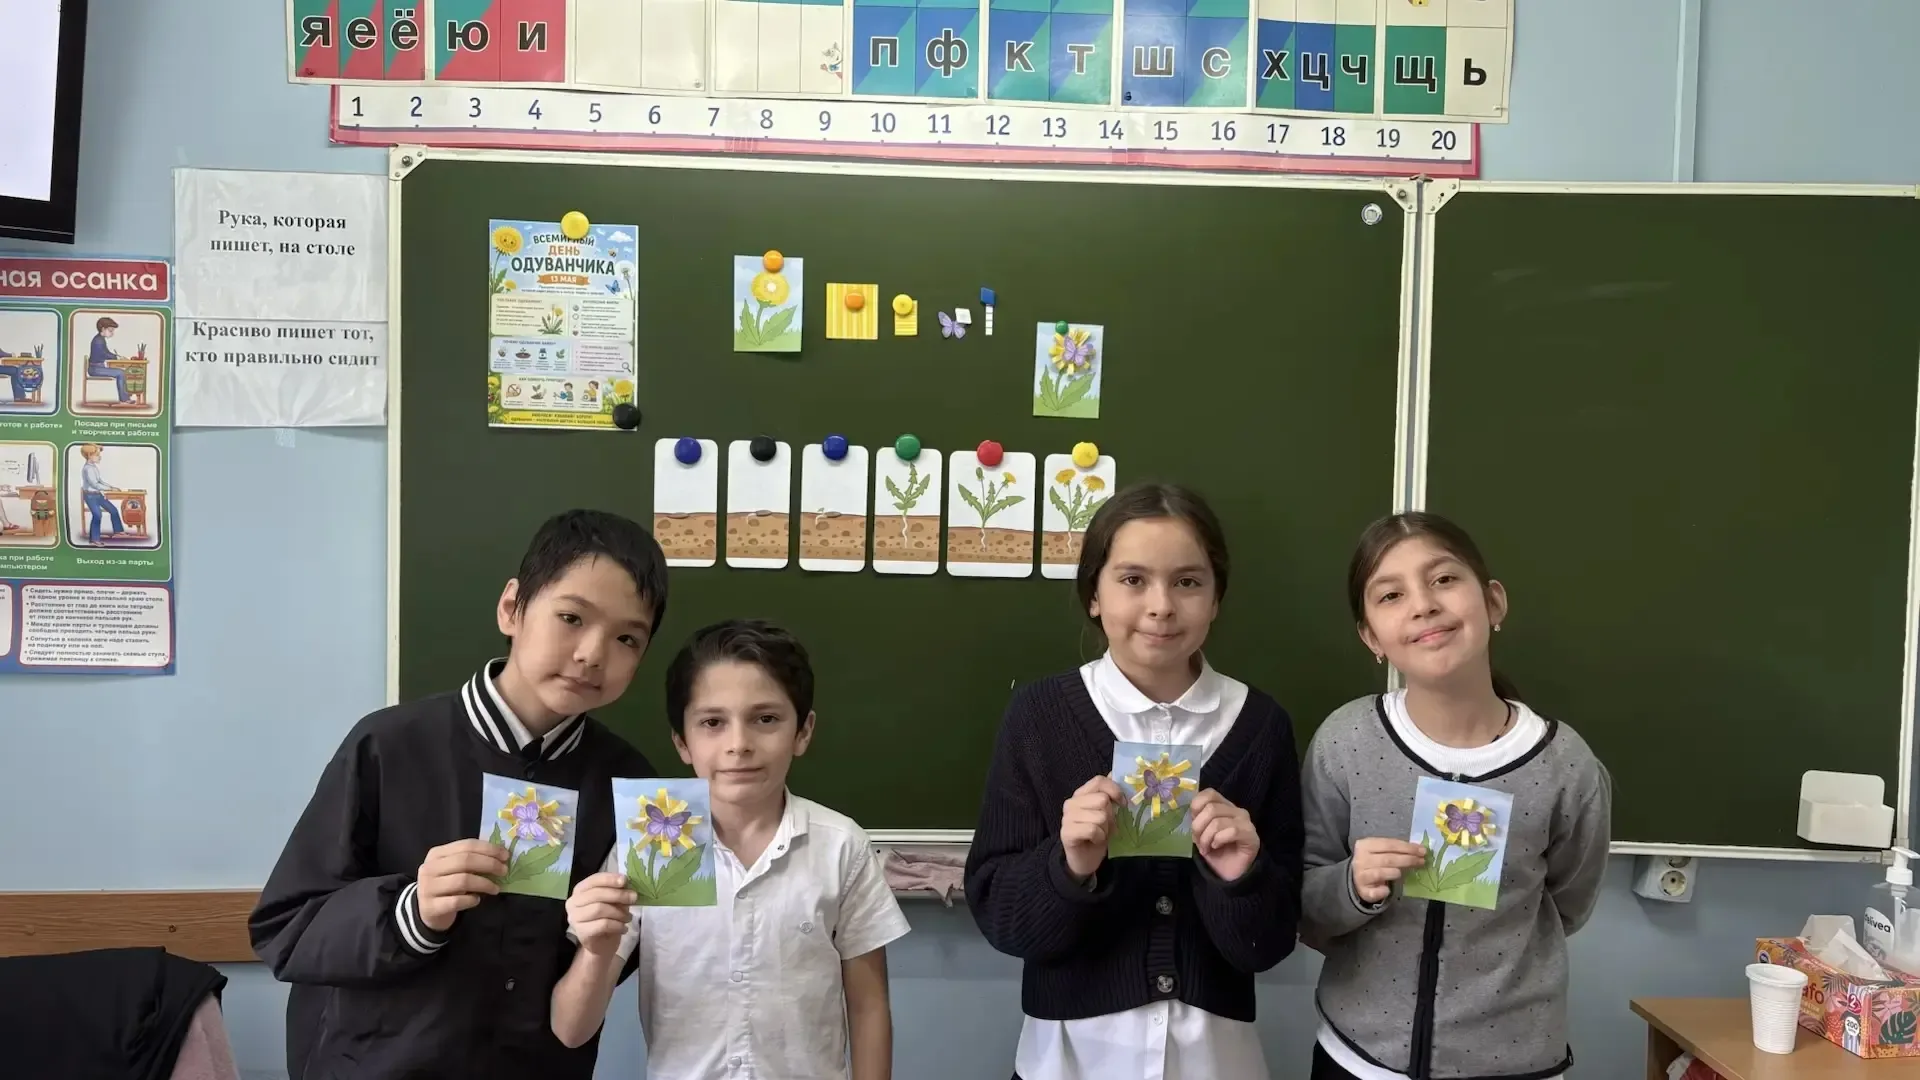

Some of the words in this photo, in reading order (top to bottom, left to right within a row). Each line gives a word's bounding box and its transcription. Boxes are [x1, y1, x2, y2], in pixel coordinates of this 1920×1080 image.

[301, 16, 332, 46] я
[346, 16, 376, 49] е
[391, 9, 419, 50] ё
[447, 20, 489, 52] ю
[518, 21, 547, 52] и
[870, 36, 899, 67] п
[926, 28, 968, 77] ф
[1005, 41, 1034, 72] к
[1067, 44, 1095, 74] т
[1133, 46, 1174, 77] ш
[1202, 47, 1231, 79] с
[1262, 49, 1289, 80] х
[1301, 52, 1330, 91] ц
[1341, 54, 1367, 84] ч
[1394, 55, 1436, 94] щ
[1463, 58, 1487, 86] ь
[352, 97, 364, 116] 1
[411, 96, 422, 117] 2
[469, 97, 481, 118] 3
[528, 99, 543, 120] 4
[589, 102, 601, 122] 5
[648, 105, 661, 124] 6
[707, 108, 720, 127] 7
[760, 109, 773, 129] 8
[819, 111, 831, 131] 9
[871, 112, 896, 133] 10
[928, 113, 952, 134] 11
[986, 115, 1010, 135] 12
[1043, 117, 1067, 138] 13
[1099, 120, 1124, 140] 14
[1154, 120, 1178, 141] 15
[1211, 121, 1236, 141] 16
[1267, 124, 1290, 144] 17
[1322, 126, 1345, 146] 18
[1377, 128, 1400, 149] 19
[1431, 130, 1456, 150] 20
[218, 210, 267, 228] Рука,
[273, 214, 346, 232] которая
[210, 239, 273, 255] пишет,
[280, 242, 299, 254] на
[306, 242, 355, 255] столе
[533, 234, 594, 246] ВСЕМИЫЙ
[548, 245, 580, 256] ДЕНЬ
[511, 257, 615, 275] ОДУВАНЧИКА
[51, 270, 158, 292] осанка
[192, 322, 271, 340] Красиво
[277, 328, 336, 340] пишет
[341, 330, 374, 343] тот,
[185, 351, 217, 362] кто
[224, 352, 322, 366] правильно
[329, 353, 379, 366] сидит
[1850, 995, 1856, 1008] 2
[1847, 1020, 1858, 1030] 200
